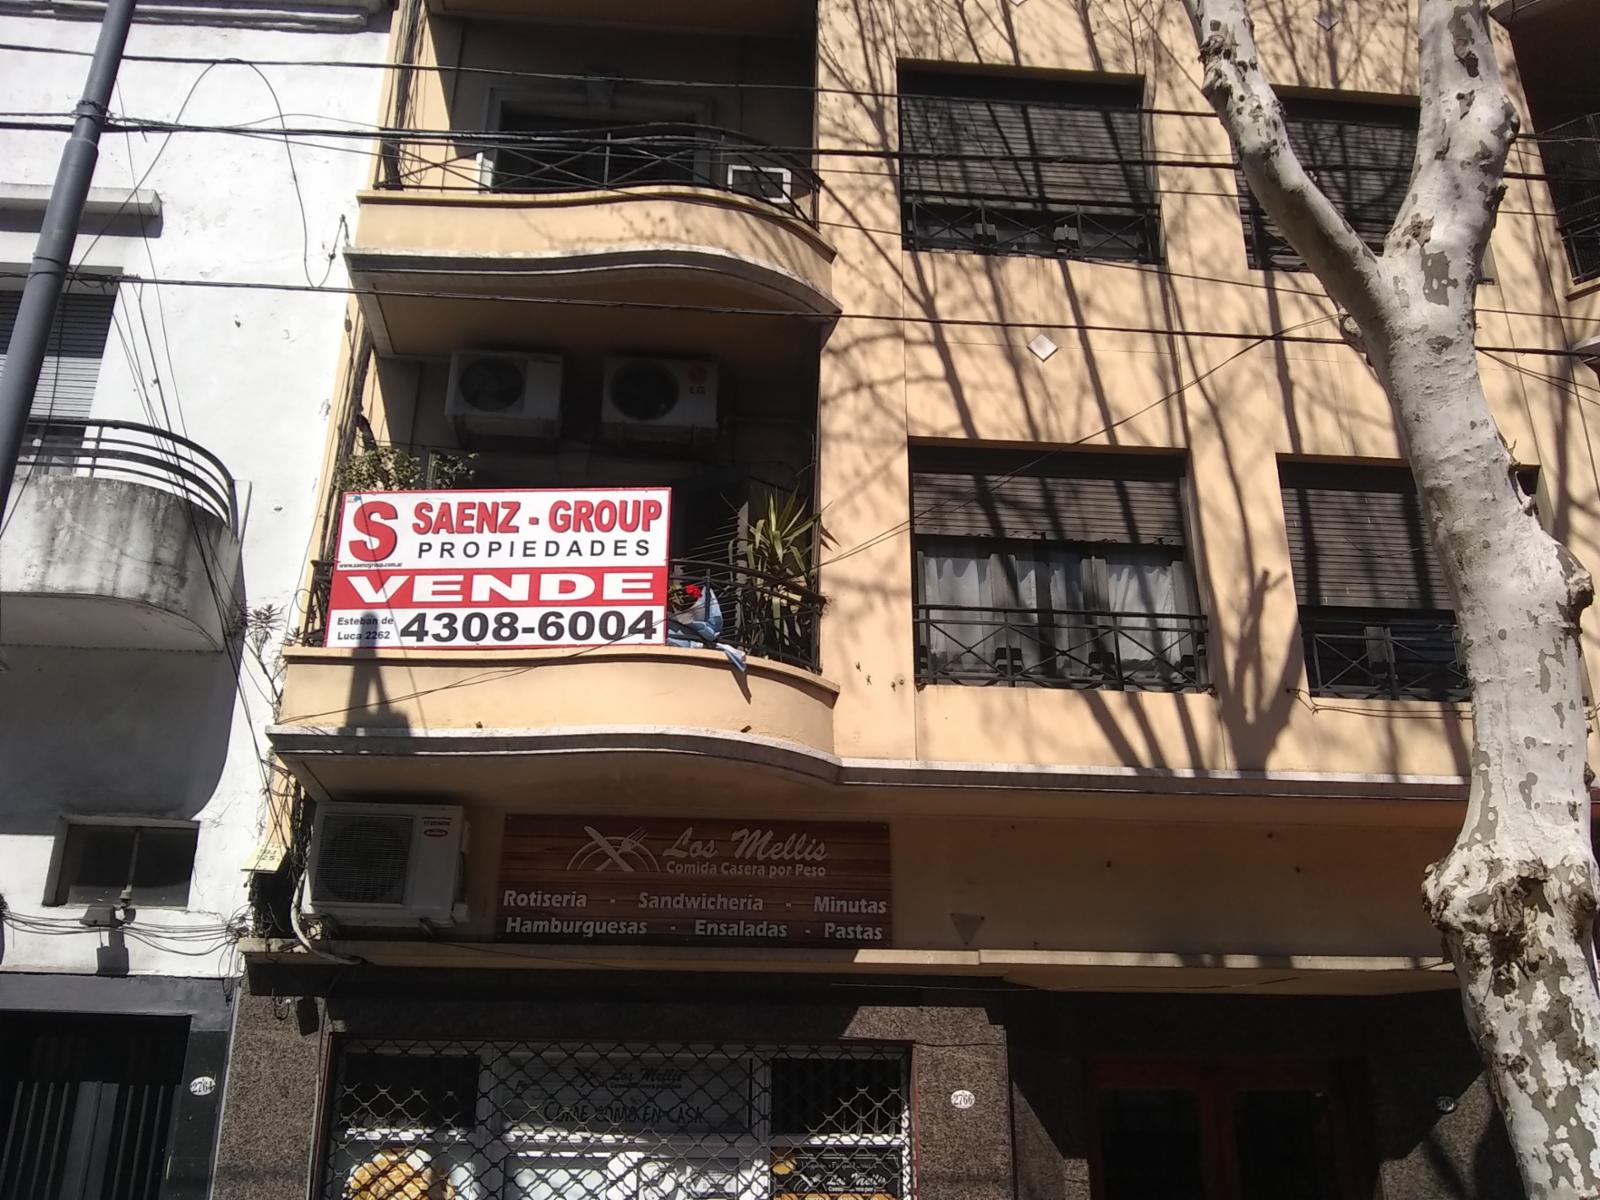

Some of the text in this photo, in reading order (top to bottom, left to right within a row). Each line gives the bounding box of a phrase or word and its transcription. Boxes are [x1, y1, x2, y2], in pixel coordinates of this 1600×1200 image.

[689, 386, 706, 394] LG
[412, 501, 521, 535] SAENZ
[549, 499, 663, 533] GROUP
[349, 501, 398, 562] S
[418, 539, 650, 559] PROPIEDADES
[347, 572, 654, 604] VENDE
[337, 616, 394, 626] Esteban de
[400, 610, 657, 643] 4308-6004
[337, 630, 391, 640] Luca 2262
[662, 827, 829, 861] Los Mellis
[666, 861, 827, 878] Comida Casera por Peso
[814, 895, 887, 914] Minutas
[505, 917, 648, 938] Hamburguesas
[695, 919, 788, 937] Ensaladas
[824, 923, 883, 940] Pastas
